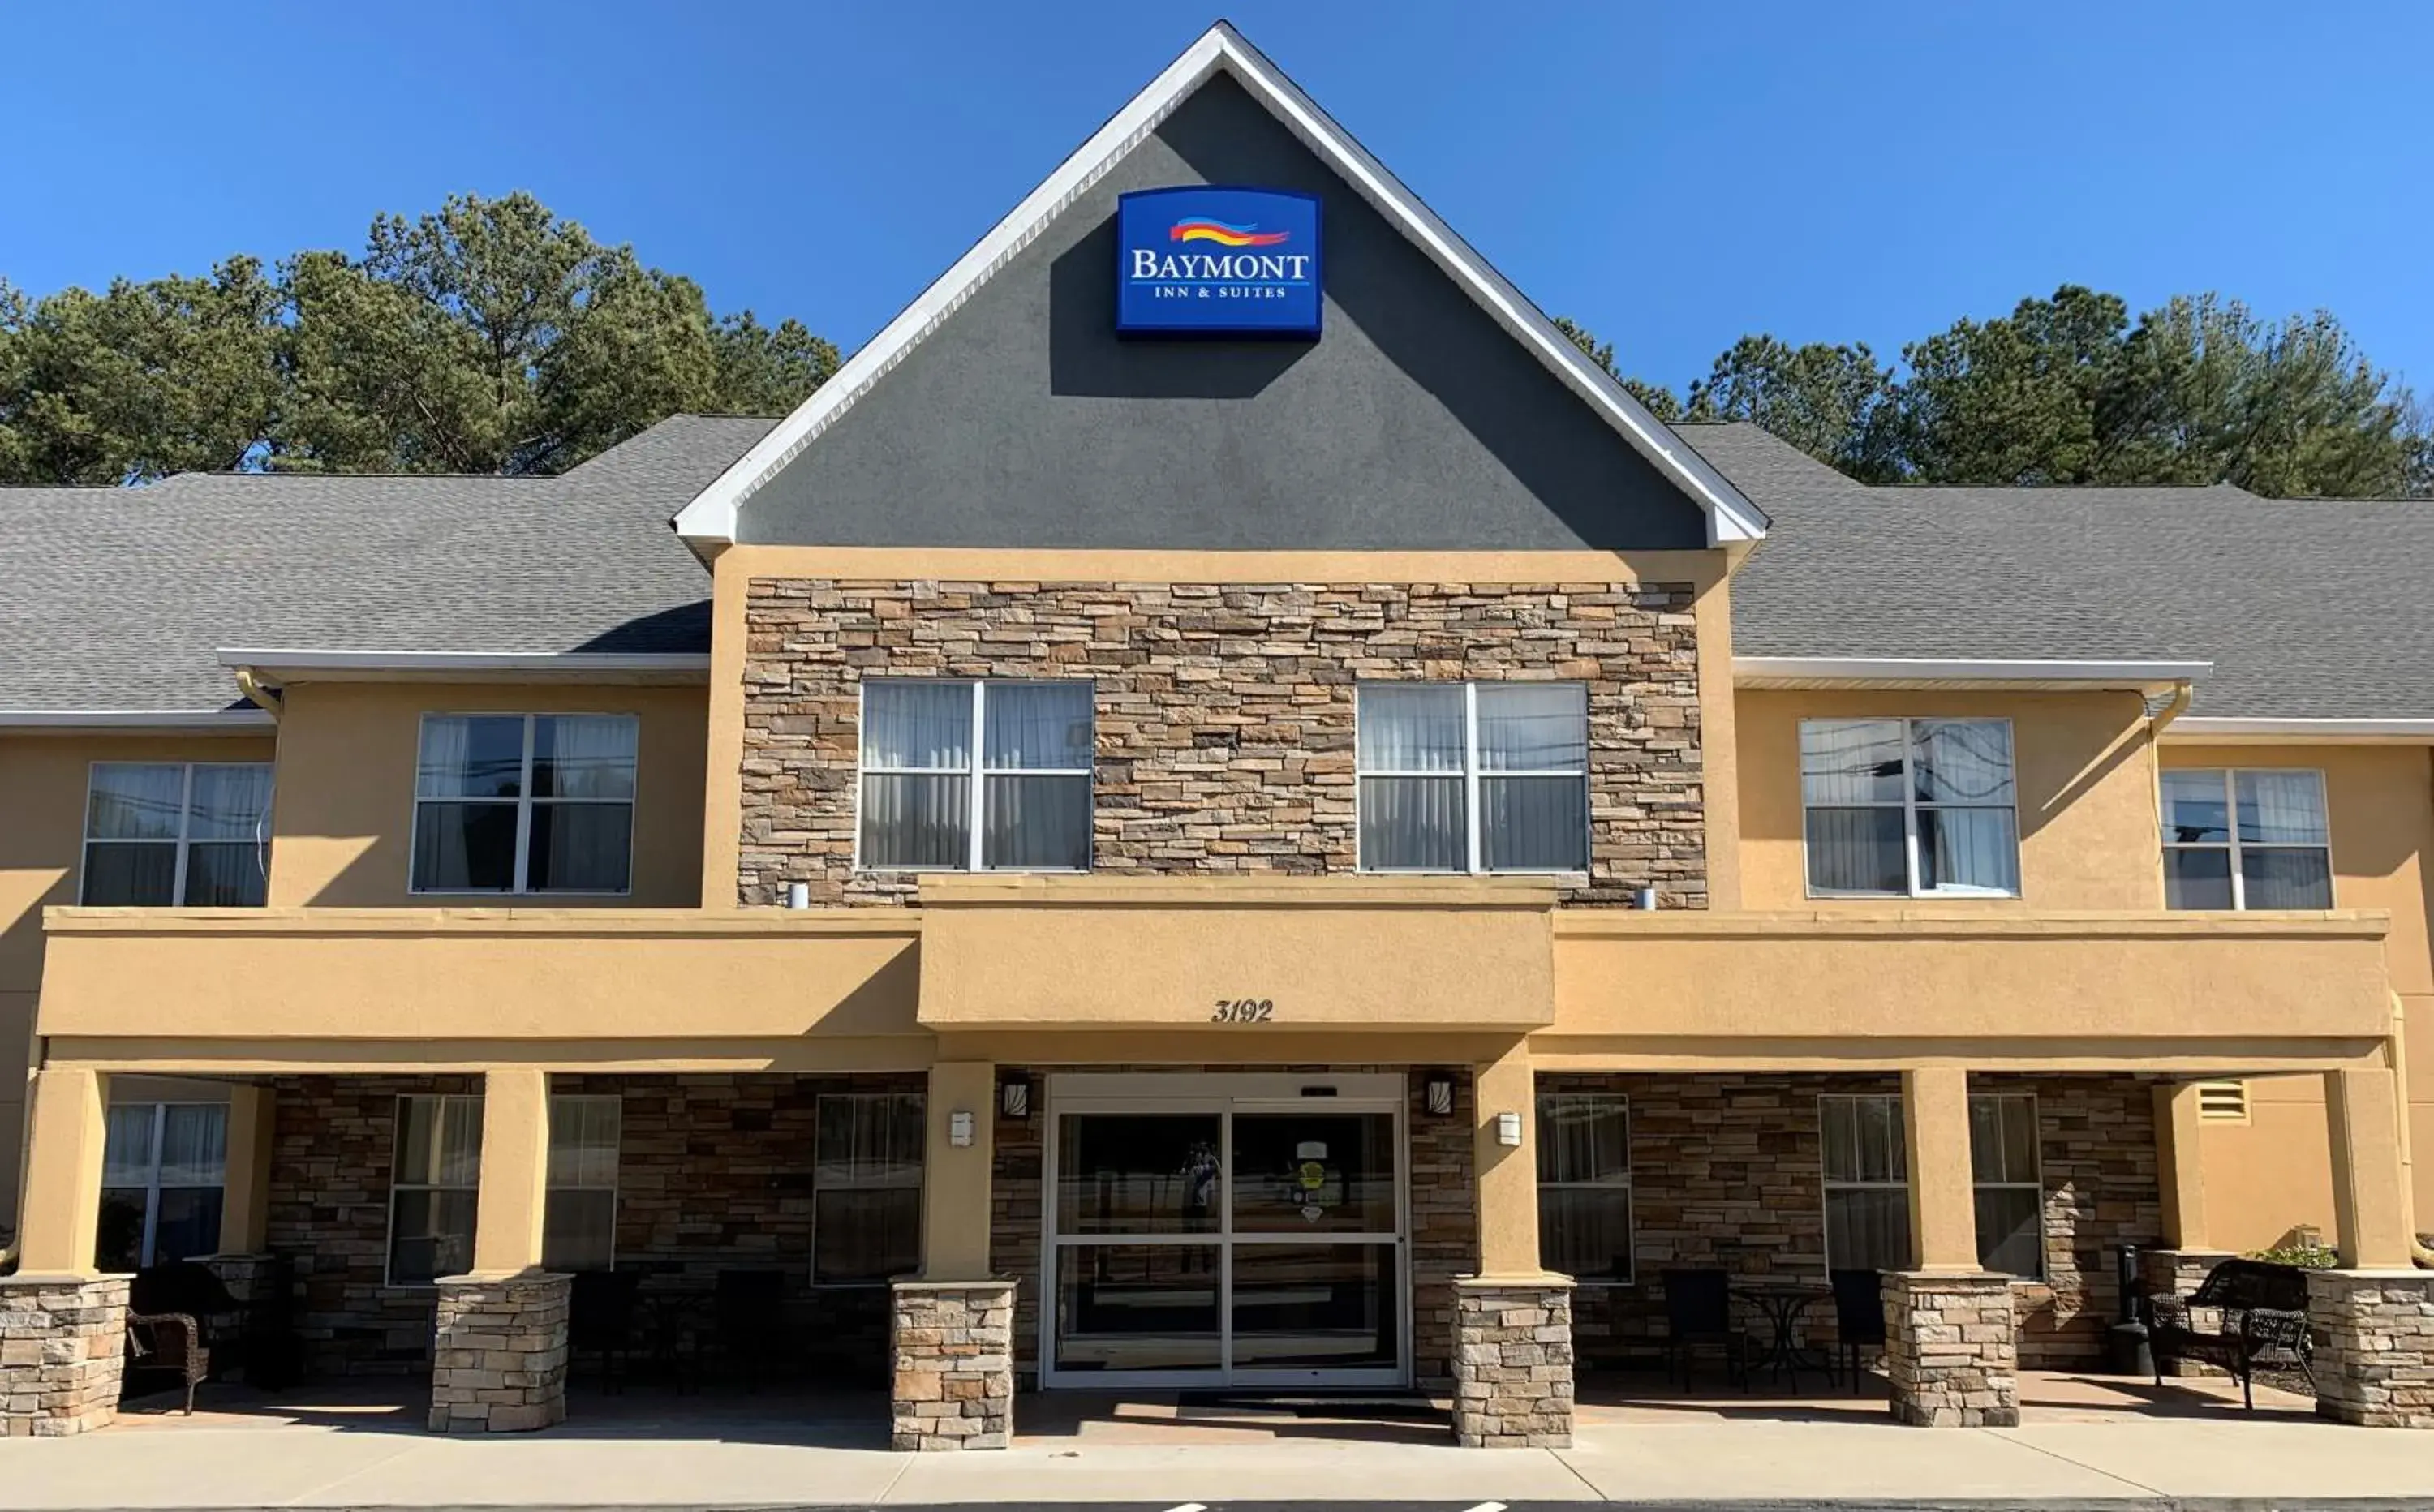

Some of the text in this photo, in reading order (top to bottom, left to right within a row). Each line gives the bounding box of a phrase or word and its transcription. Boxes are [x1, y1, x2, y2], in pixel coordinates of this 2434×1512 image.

[1131, 249, 1309, 279] BAYMONT
[1155, 287, 1286, 298] INN & SUITES
[1211, 999, 1273, 1022] 3192
